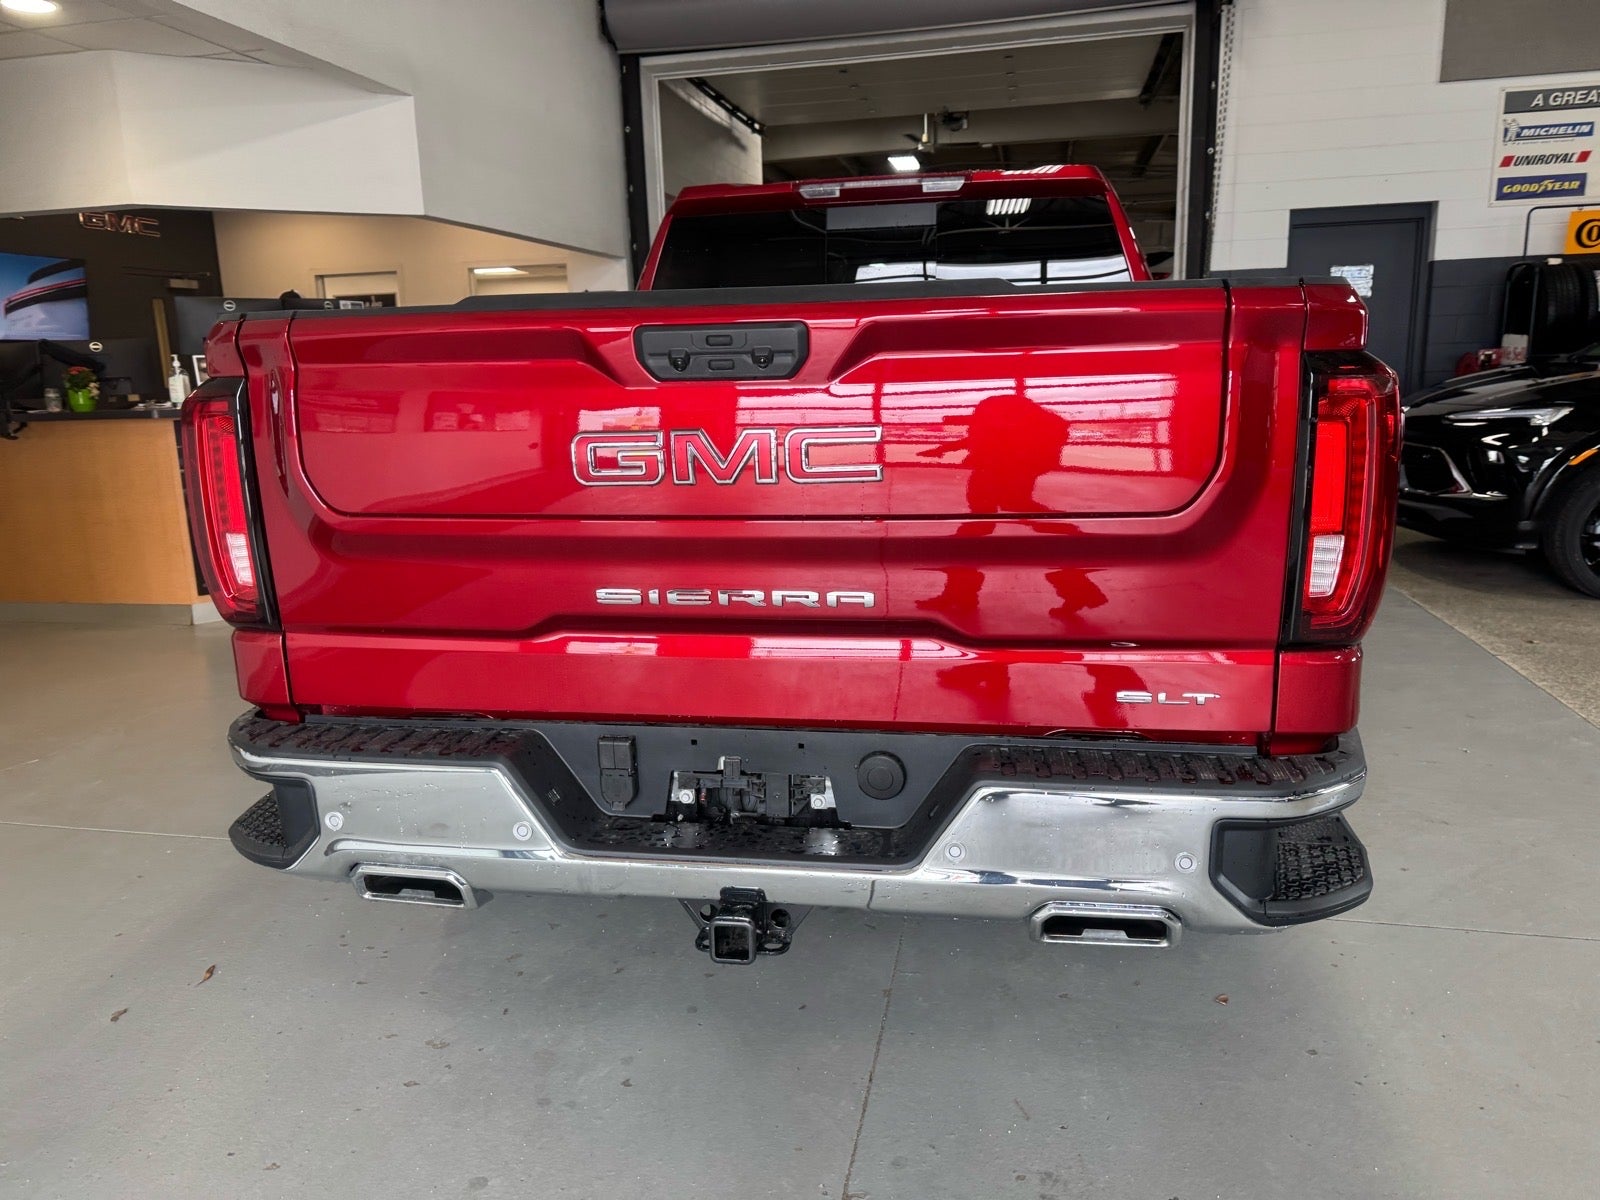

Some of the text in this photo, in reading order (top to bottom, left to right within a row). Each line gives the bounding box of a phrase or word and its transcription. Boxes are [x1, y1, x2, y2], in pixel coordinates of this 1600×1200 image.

[1530, 93, 1544, 107] A
[1520, 125, 1592, 137] MICHELIN
[1513, 152, 1576, 166] UNIROYAL
[1502, 179, 1581, 193] GOODYEAR
[79, 211, 161, 238] GMC
[571, 425, 883, 486] GMC
[595, 588, 876, 608] SIERRA
[1116, 690, 1221, 705] SLT
